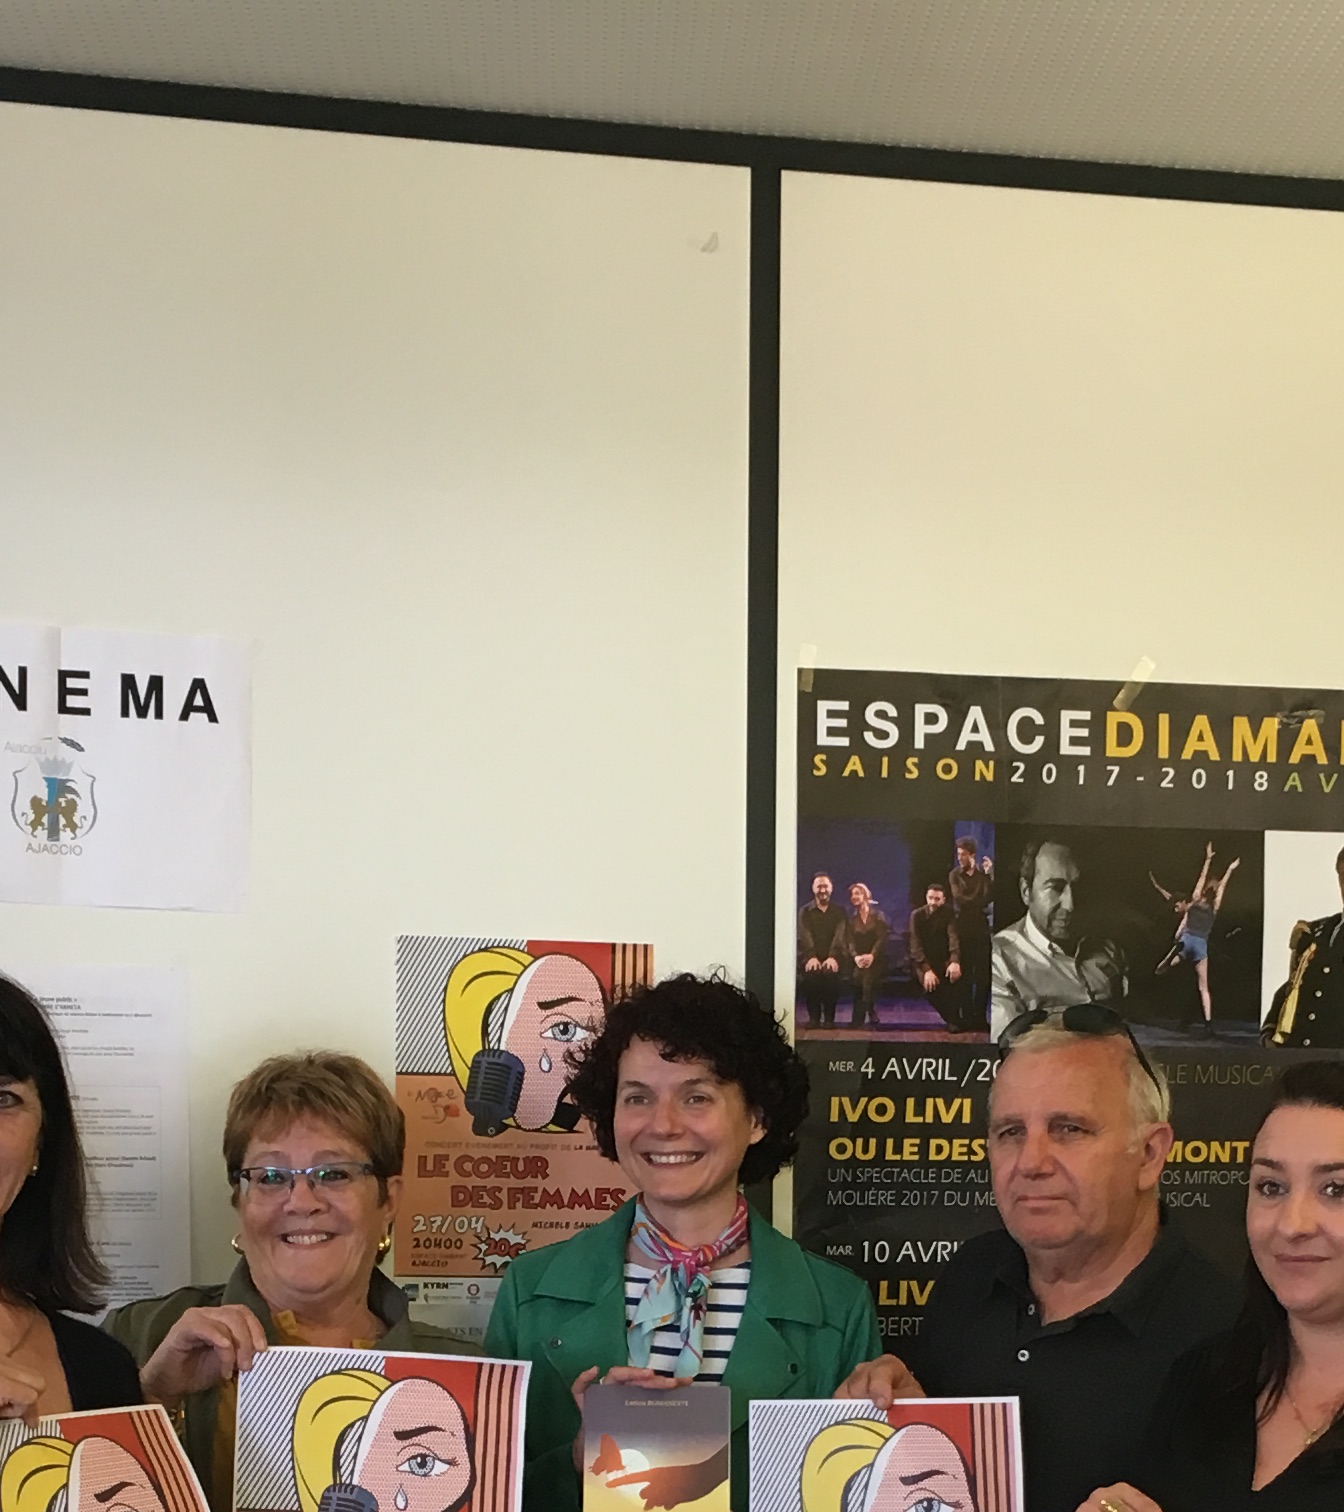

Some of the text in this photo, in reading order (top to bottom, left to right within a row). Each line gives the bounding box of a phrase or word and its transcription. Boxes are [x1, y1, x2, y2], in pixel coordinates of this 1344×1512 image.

[25, 842, 83, 856] AJACCIO
[828, 1061, 856, 1072] MER.
[861, 1057, 875, 1079] 4
[881, 1058, 957, 1081] AVRIL
[829, 1097, 972, 1124] IVO LIVI
[828, 1137, 876, 1161] OU
[885, 1138, 920, 1161] LE
[417, 1154, 550, 1180] LE COEUR
[828, 1168, 852, 1182] UN
[856, 1167, 937, 1183] SPECTACLE
[941, 1169, 962, 1183] DE
[451, 1185, 626, 1213] DES FEMMES
[826, 1187, 896, 1206] MOLIÈRE
[901, 1190, 938, 1206] 2017
[944, 1191, 969, 1206] DU
[412, 1215, 485, 1235] 27/04
[412, 1237, 463, 1249] 20H00
[826, 1245, 854, 1255] MAR.
[862, 1241, 890, 1263] 10
